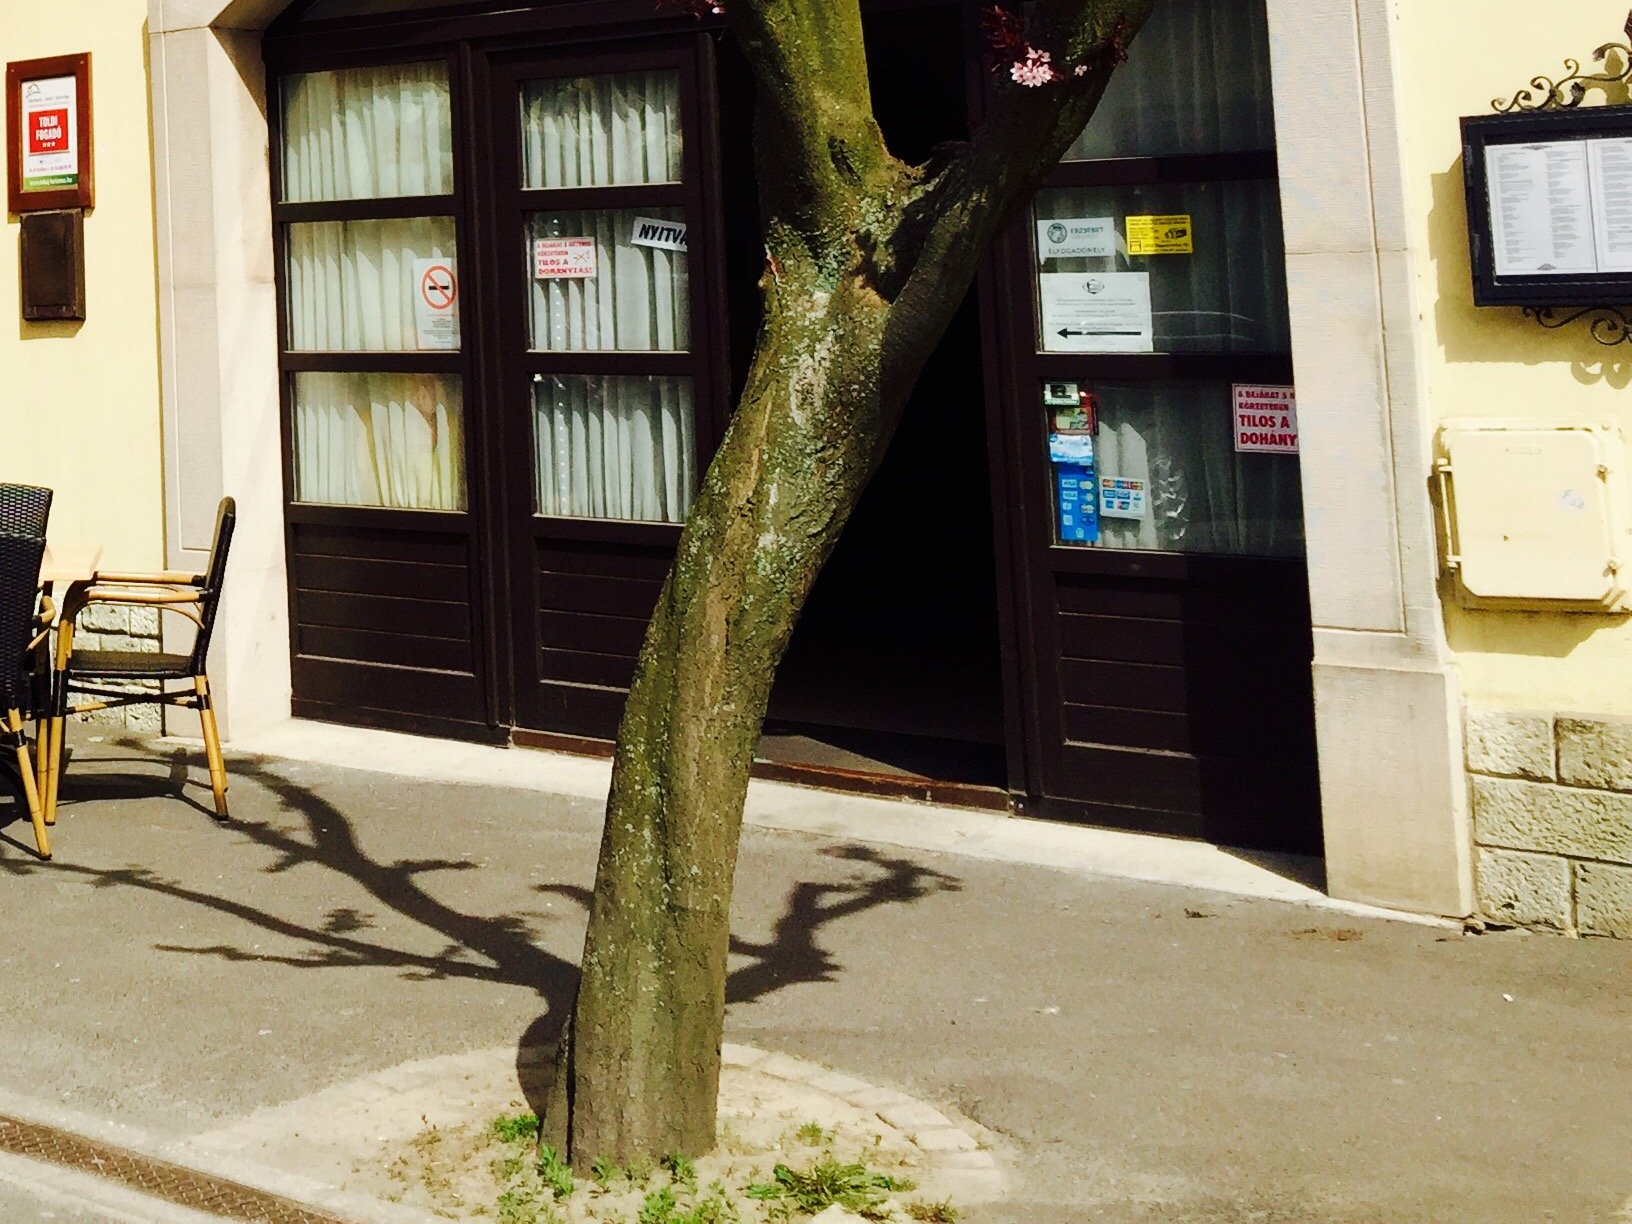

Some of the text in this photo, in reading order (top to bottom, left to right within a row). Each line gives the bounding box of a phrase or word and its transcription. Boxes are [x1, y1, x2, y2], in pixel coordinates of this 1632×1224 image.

[38, 115, 59, 128] TOLDI
[1239, 414, 1290, 429] TILOS A
[1240, 430, 1297, 446] DOHÁNY
